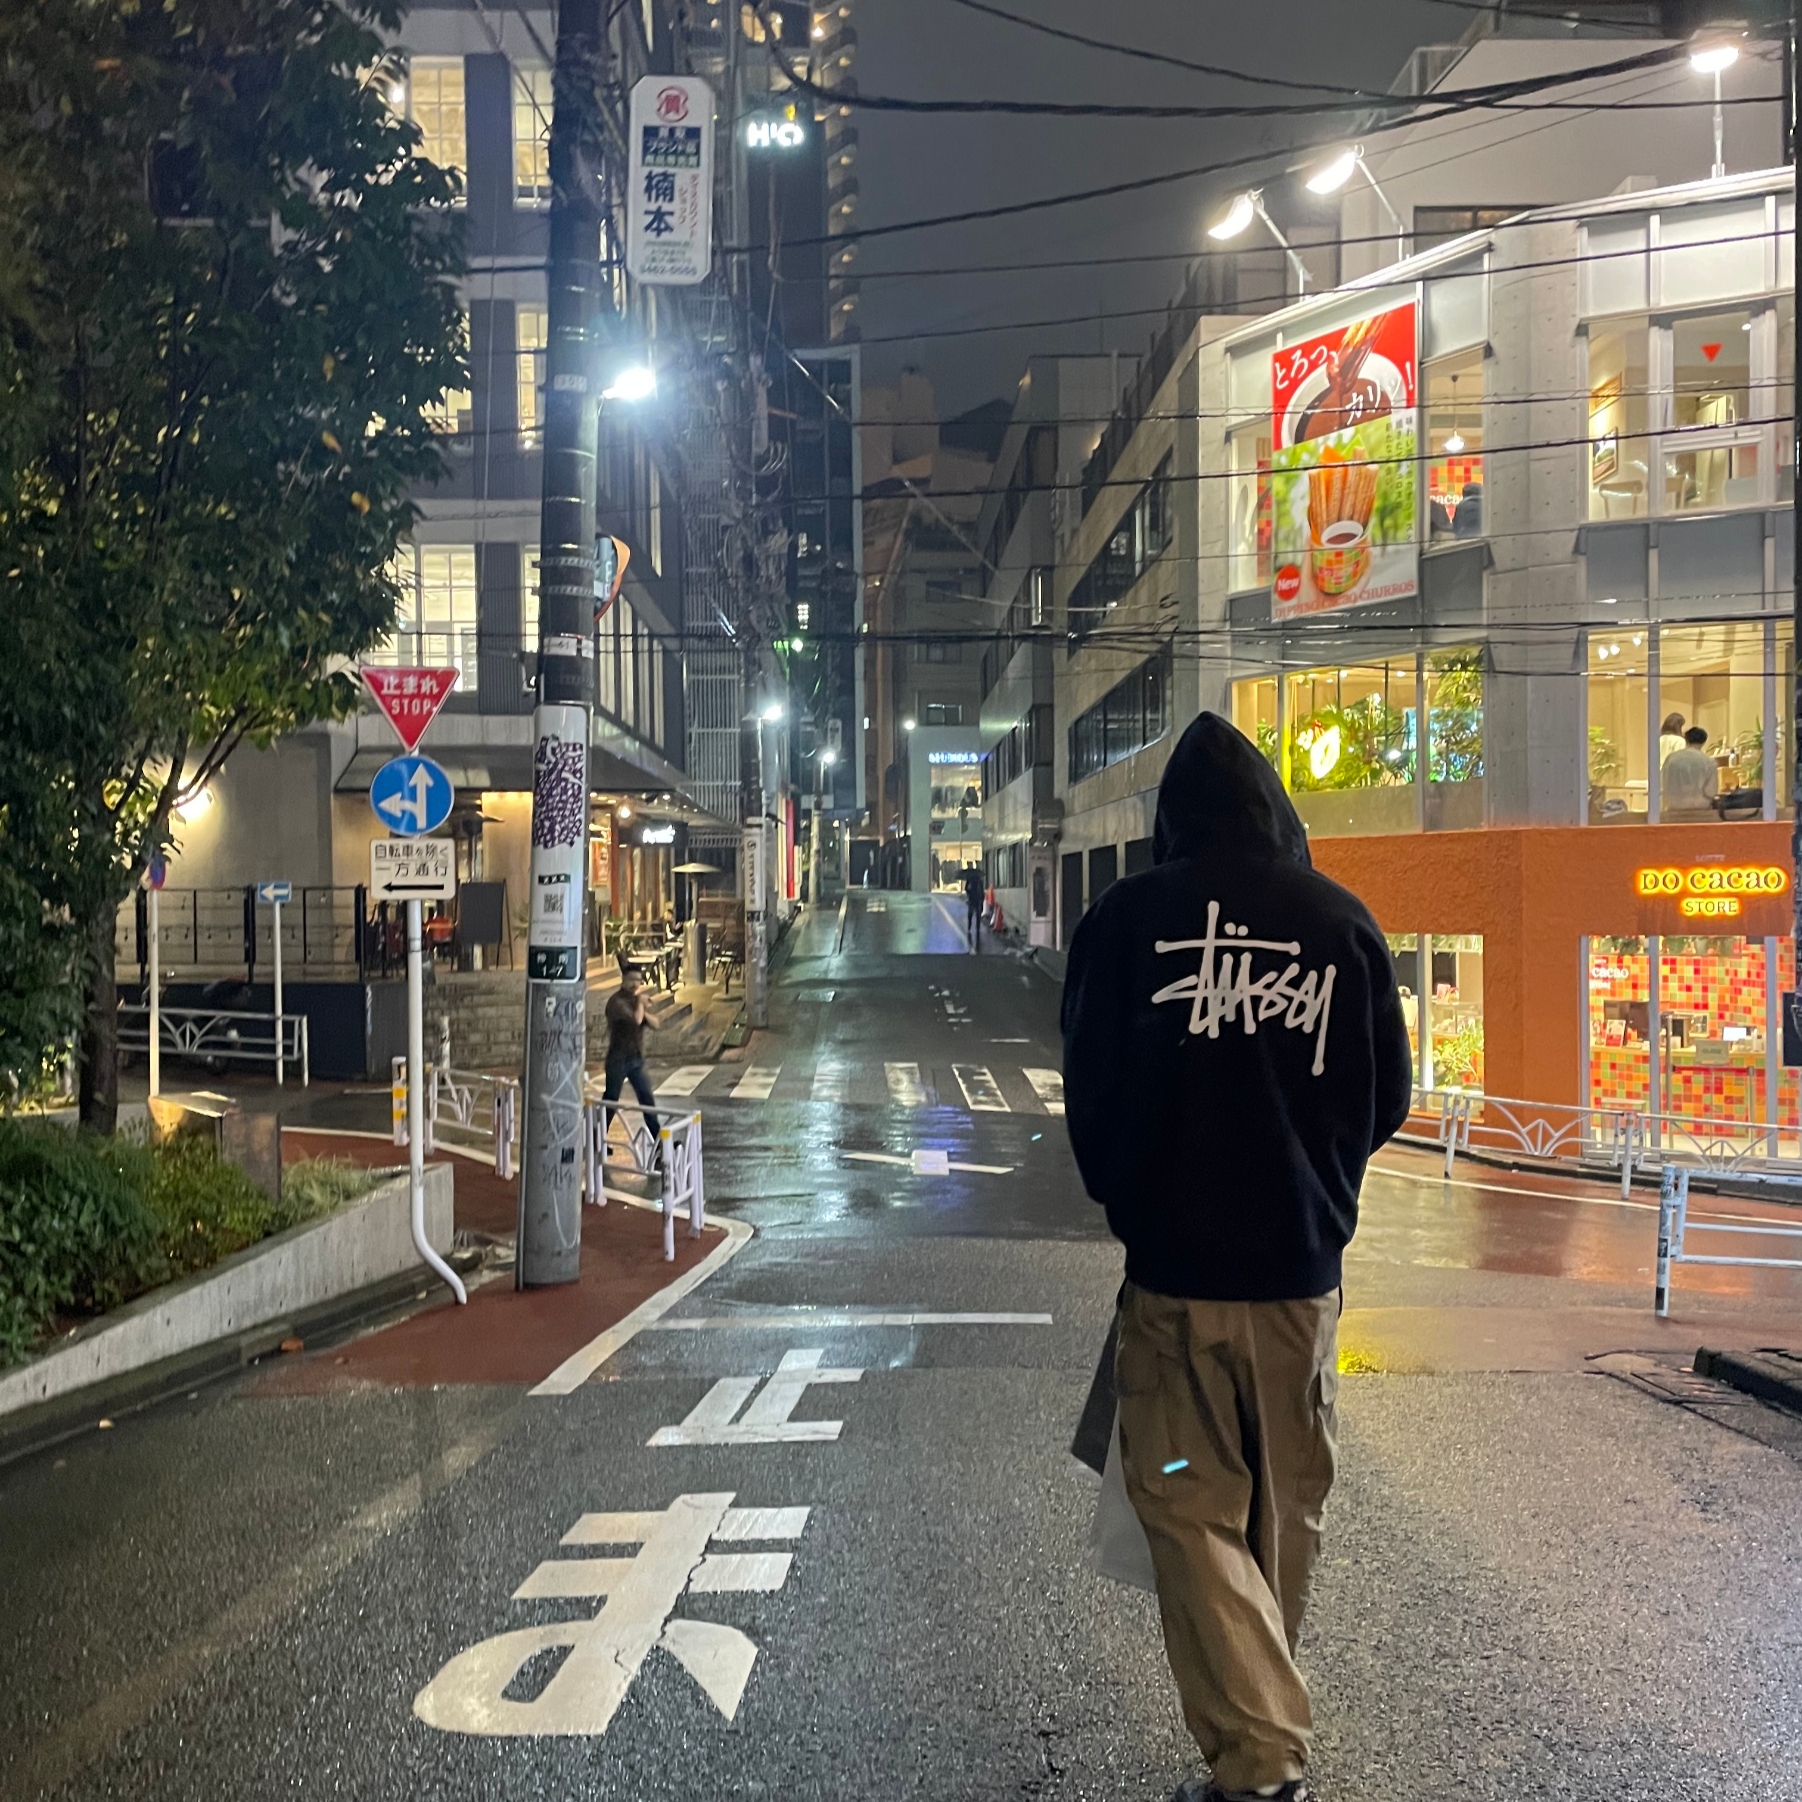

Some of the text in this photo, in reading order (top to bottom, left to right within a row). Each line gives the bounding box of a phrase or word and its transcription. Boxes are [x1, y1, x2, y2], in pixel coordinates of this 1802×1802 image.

[643, 169, 676, 238] 楠本
[1277, 576, 1300, 591] New
[1359, 580, 1415, 601] CHURROS
[380, 674, 440, 696] 止まれ
[391, 698, 431, 715] STOP
[375, 843, 449, 859] 自転車を除く
[375, 861, 448, 877] 一方通行
[1641, 872, 1680, 891] DO
[1685, 900, 1738, 913] STORE
[1591, 966, 1630, 980] cacao
